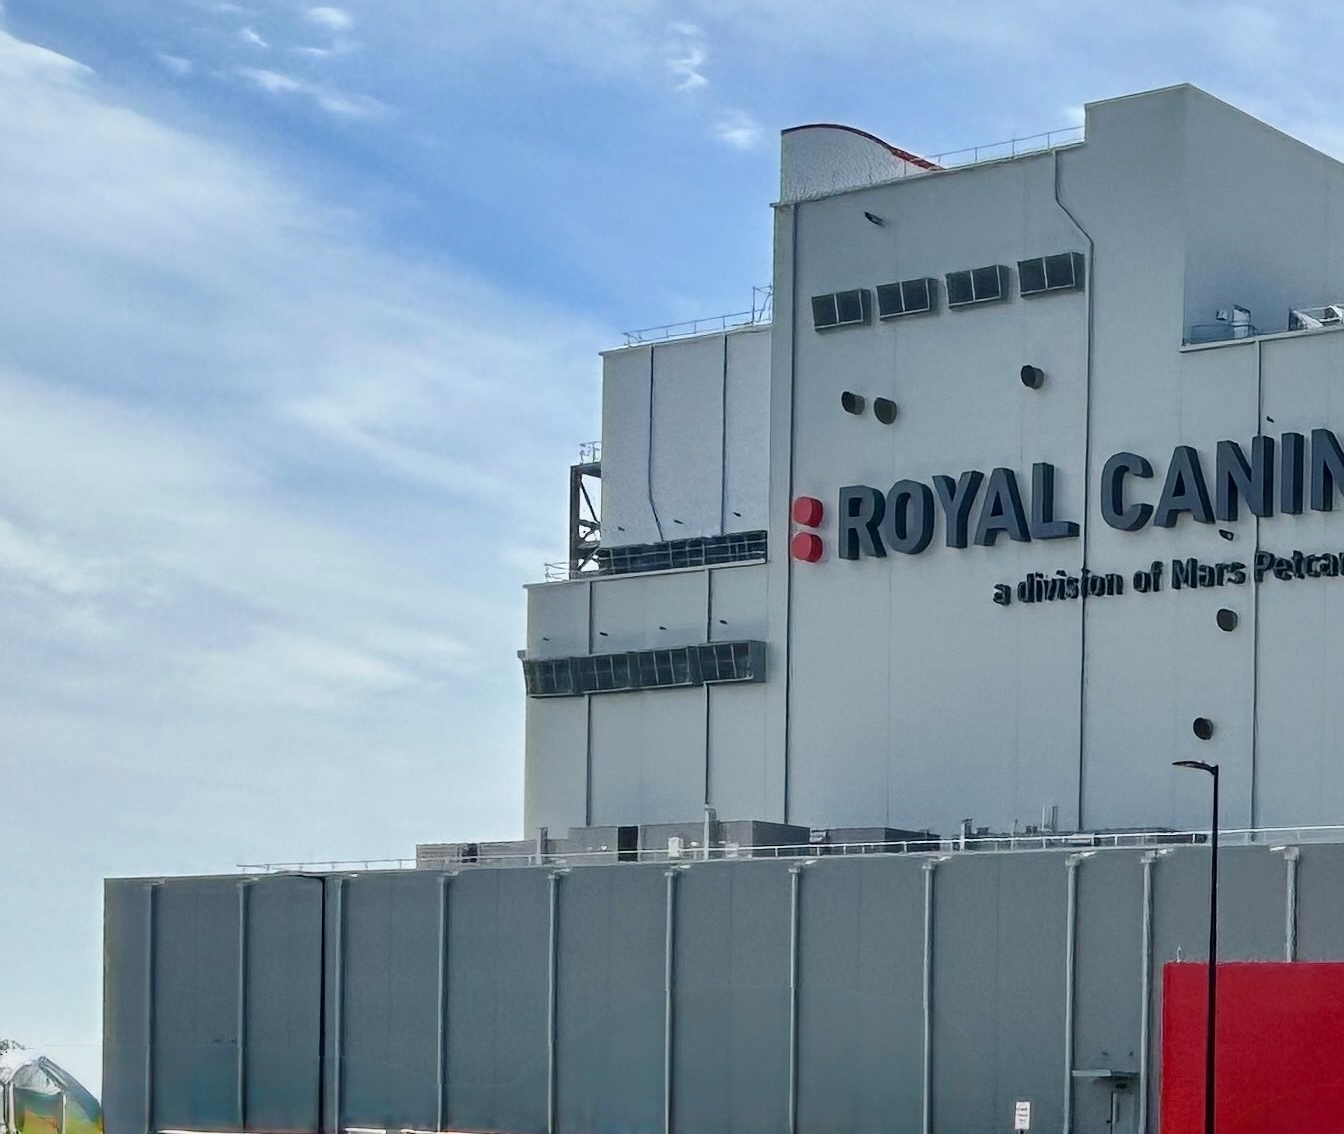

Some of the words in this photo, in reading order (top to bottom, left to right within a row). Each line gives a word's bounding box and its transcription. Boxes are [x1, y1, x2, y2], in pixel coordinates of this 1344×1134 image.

[838, 462, 1079, 559] ROYAL
[993, 582, 1011, 605] a
[1017, 569, 1123, 603] division
[1133, 561, 1163, 593] of
[1171, 557, 1246, 590] Mars
